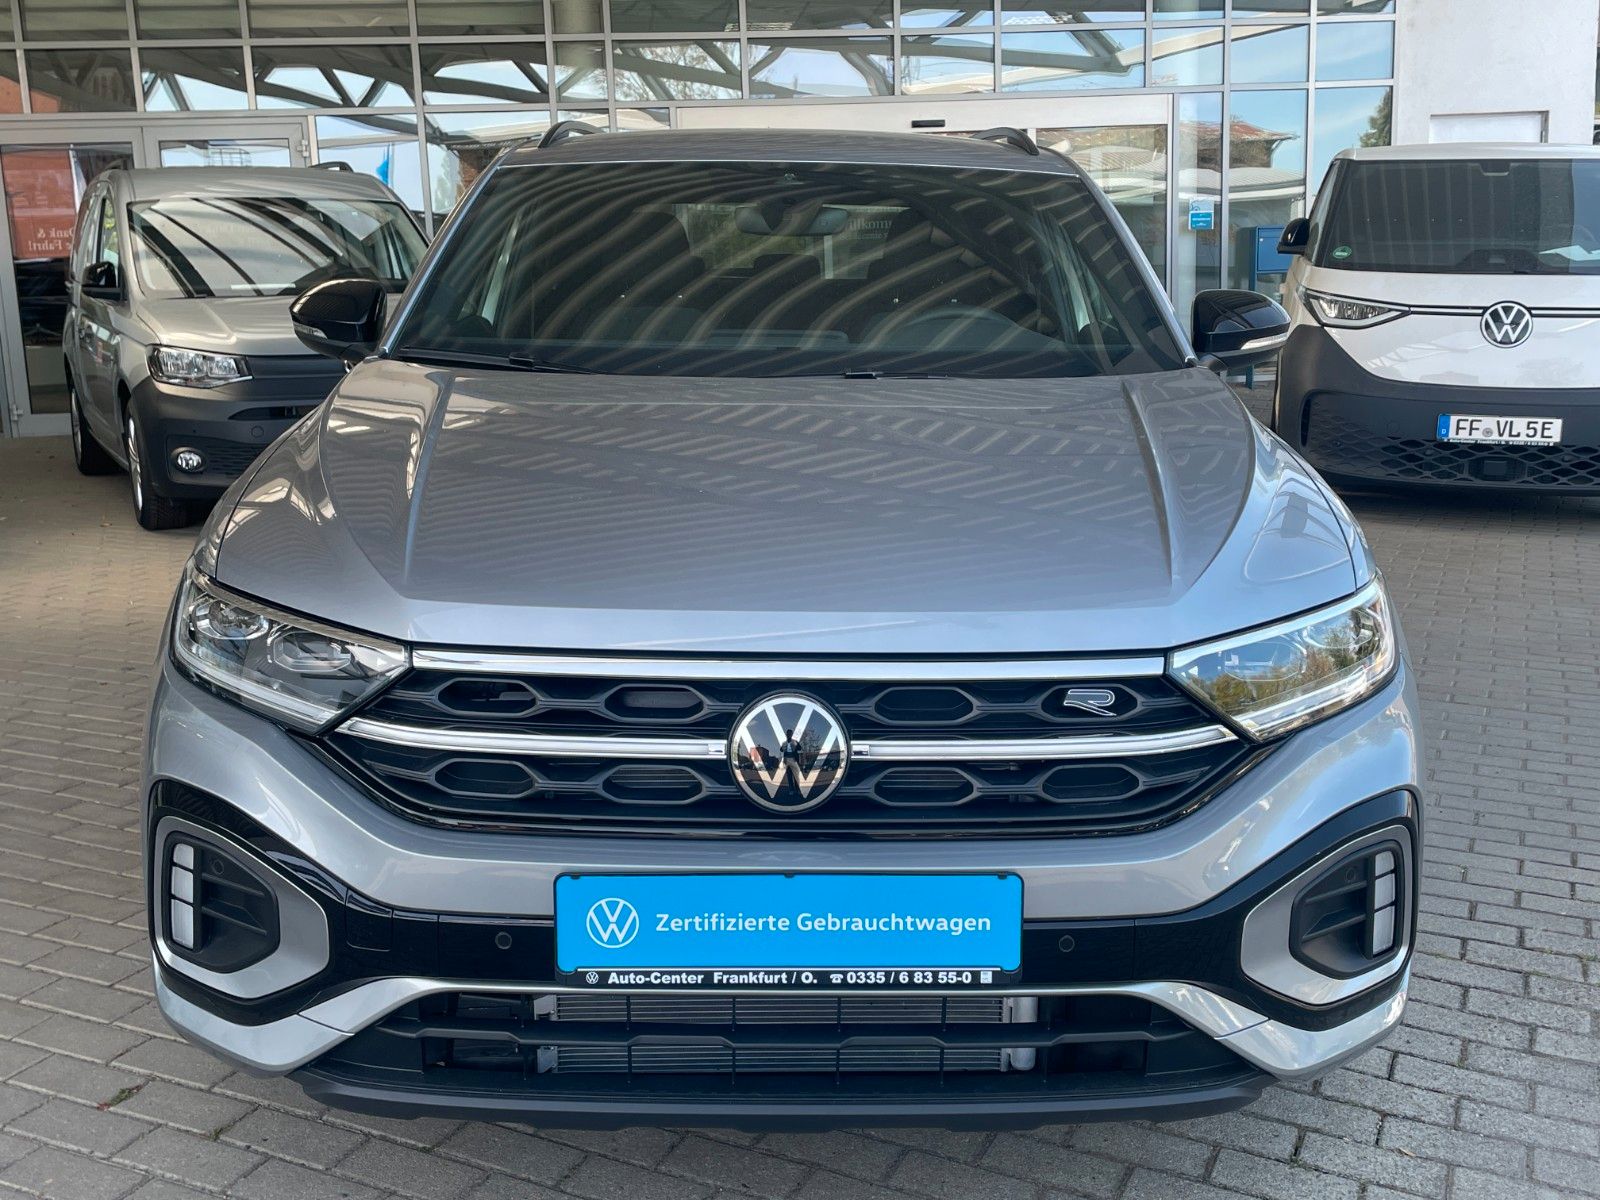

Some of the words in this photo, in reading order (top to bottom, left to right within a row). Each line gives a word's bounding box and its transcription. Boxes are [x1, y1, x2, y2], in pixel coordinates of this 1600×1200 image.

[1455, 418, 1483, 437] FF
[655, 912, 791, 932] Zertifizierte
[797, 912, 992, 936] Gebrauchtwagen
[607, 971, 705, 985] Auto-Center
[713, 971, 788, 985] Frankfurt
[846, 971, 886, 985] 0335
[937, 971, 972, 985] 55-0
